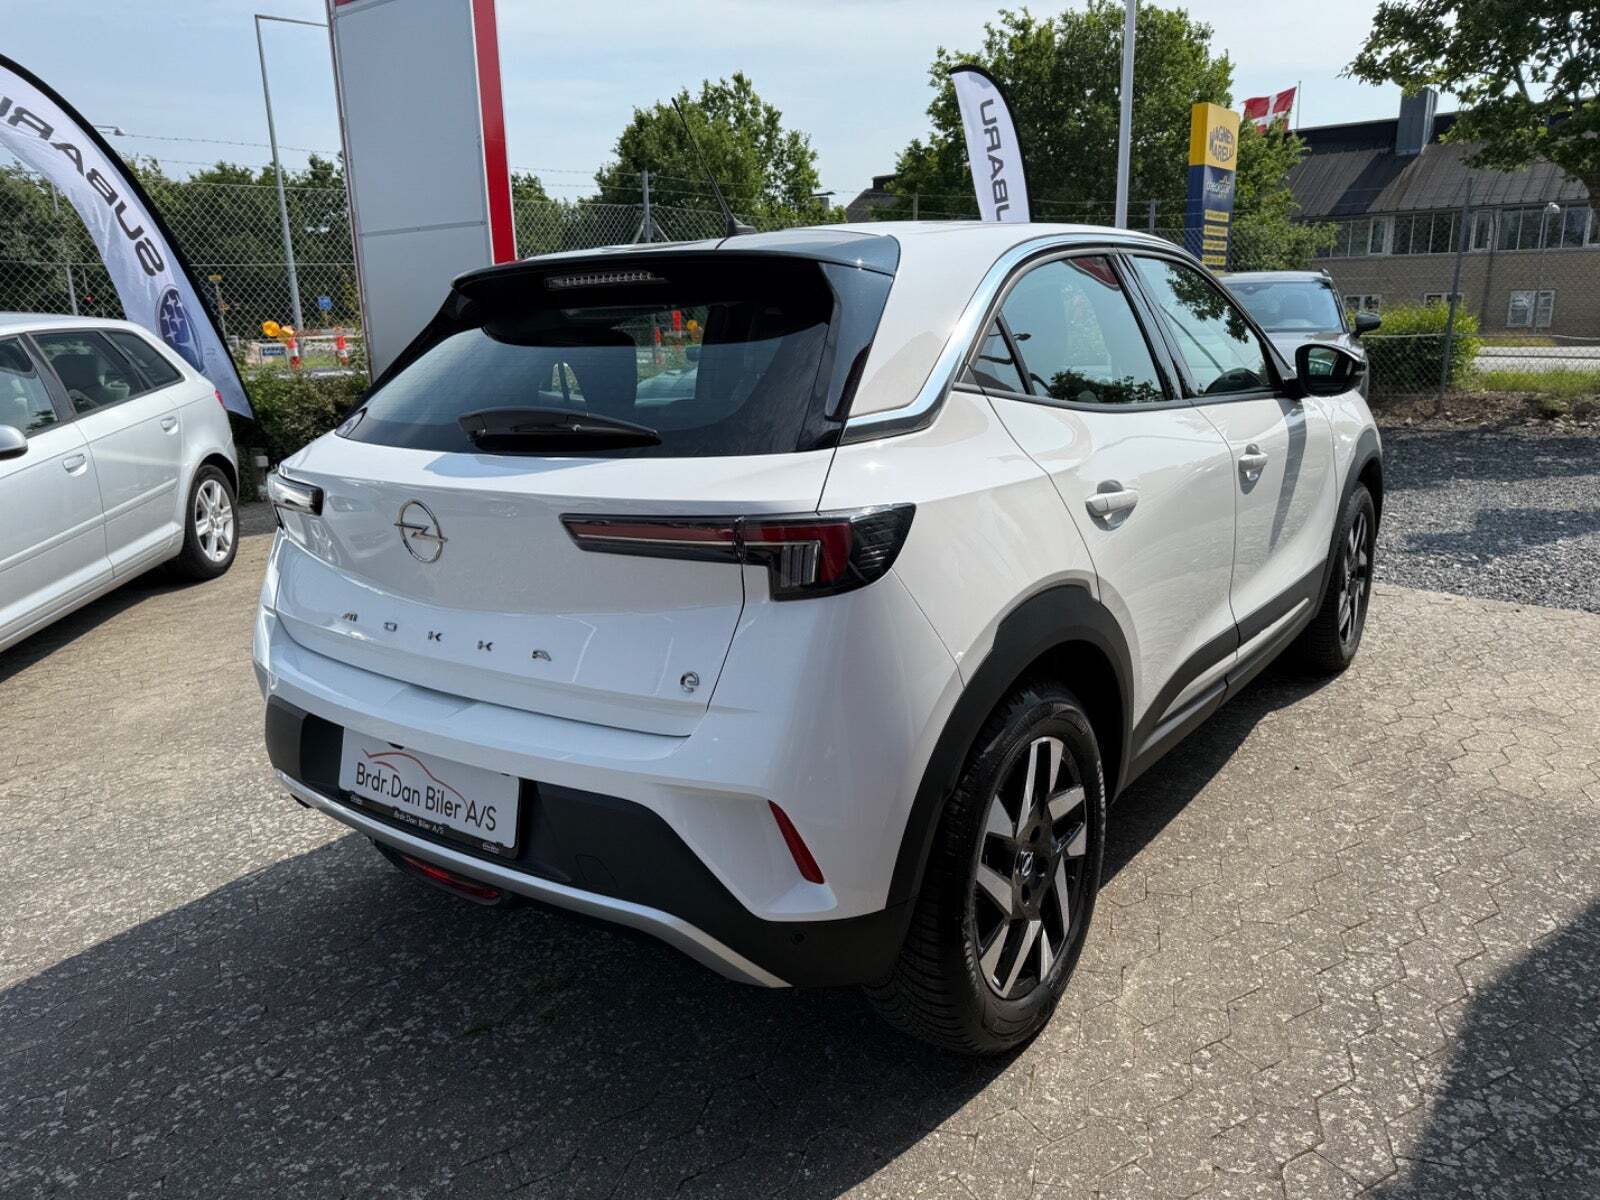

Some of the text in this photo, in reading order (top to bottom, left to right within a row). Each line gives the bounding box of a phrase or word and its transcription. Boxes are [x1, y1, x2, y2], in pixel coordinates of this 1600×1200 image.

[356, 762, 497, 832] Brdr.Dan Biler A/S
